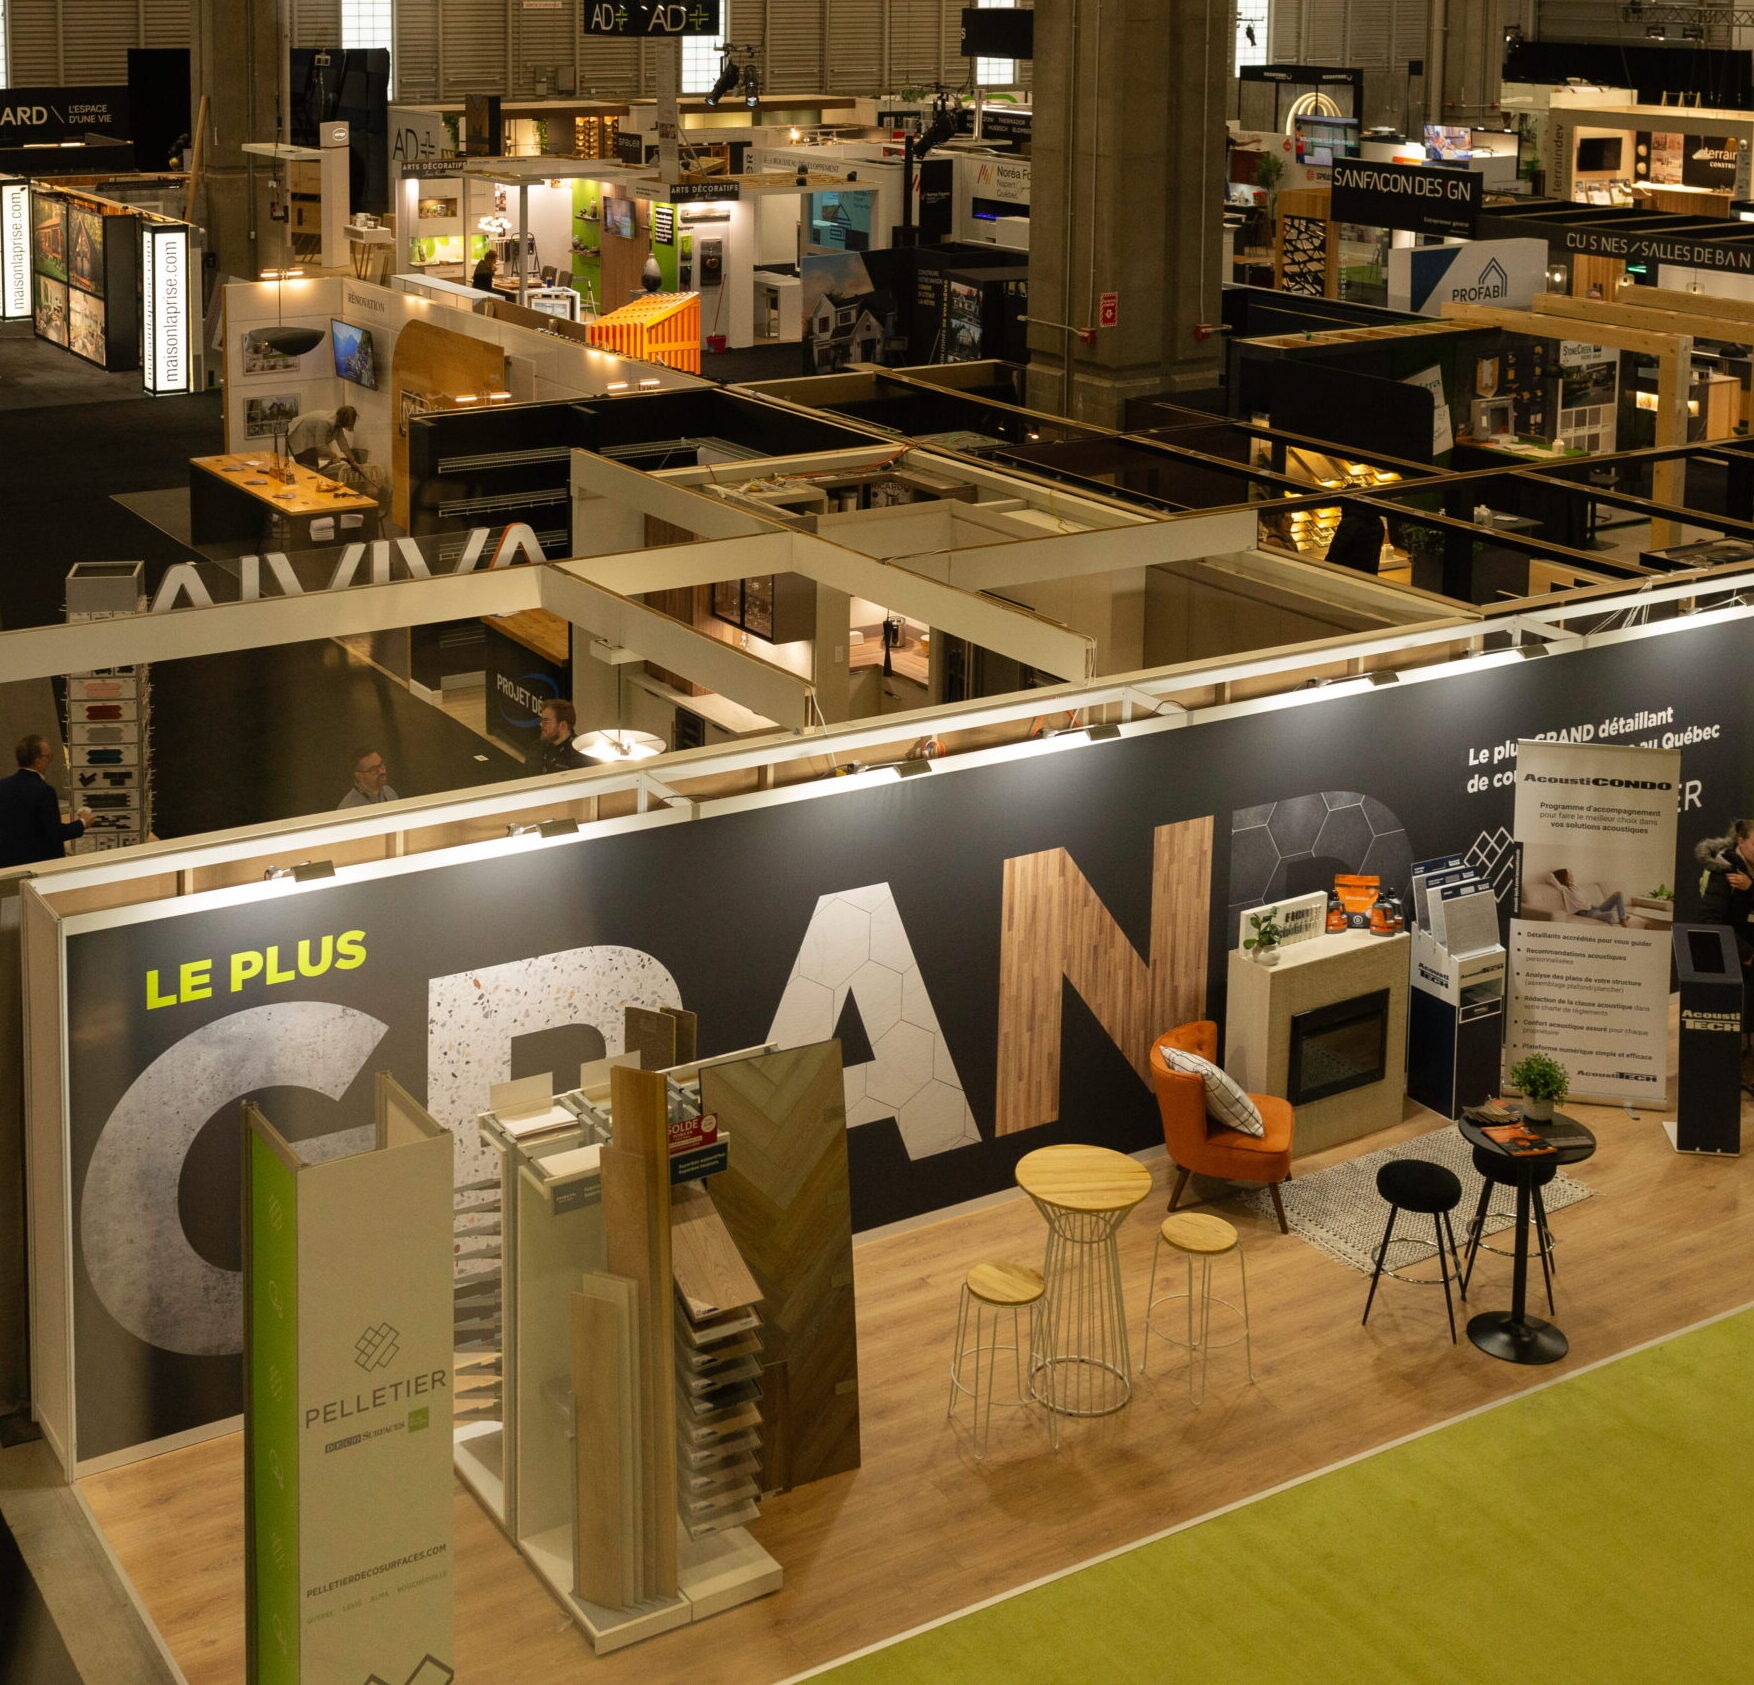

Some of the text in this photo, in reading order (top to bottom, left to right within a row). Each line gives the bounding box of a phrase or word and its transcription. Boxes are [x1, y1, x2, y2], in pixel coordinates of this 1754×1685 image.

[68, 104, 108, 114] L'ESPACE
[68, 114, 113, 124] D'UNE VIE
[402, 162, 420, 171] ARTS
[997, 166, 1020, 179] Noréa
[1334, 167, 1413, 194] SANFAÇON
[671, 185, 689, 194] ARTS
[692, 183, 739, 194] DÉCORATIFS
[10, 190, 26, 310] maisonlaprise.com
[162, 240, 181, 383] maisonlaprise.com
[496, 672, 531, 709] PROJET
[1468, 747, 1490, 766] Le
[1493, 740, 1518, 765] plu
[1598, 706, 1674, 738] détaillant
[1467, 773, 1489, 794] de
[1661, 724, 1720, 750] Québec
[1524, 773, 1672, 791] AcoustiCONDO
[1540, 802, 1661, 817] Programme d'accompagnement
[1540, 812, 1658, 826] pour faire le meilleur choix dans
[1566, 822, 1600, 831] solutions
[1602, 824, 1648, 834] acoustiques
[1597, 937, 1612, 945] pour
[1526, 947, 1627, 962] Recommandations acoustiques
[146, 929, 367, 1010] LE PLUS
[1525, 971, 1551, 980] Analyse
[1597, 1001, 1633, 1010] acoustique
[1682, 1009, 1741, 1020] Acousti
[1549, 1022, 1584, 1031] acoustique
[1682, 1018, 1741, 1032] TECH
[667, 1118, 699, 1136] SOLDE
[305, 1369, 447, 1429] PELLETIER
[306, 1543, 447, 1598] PELLETIERDECOSURFACES.COM
